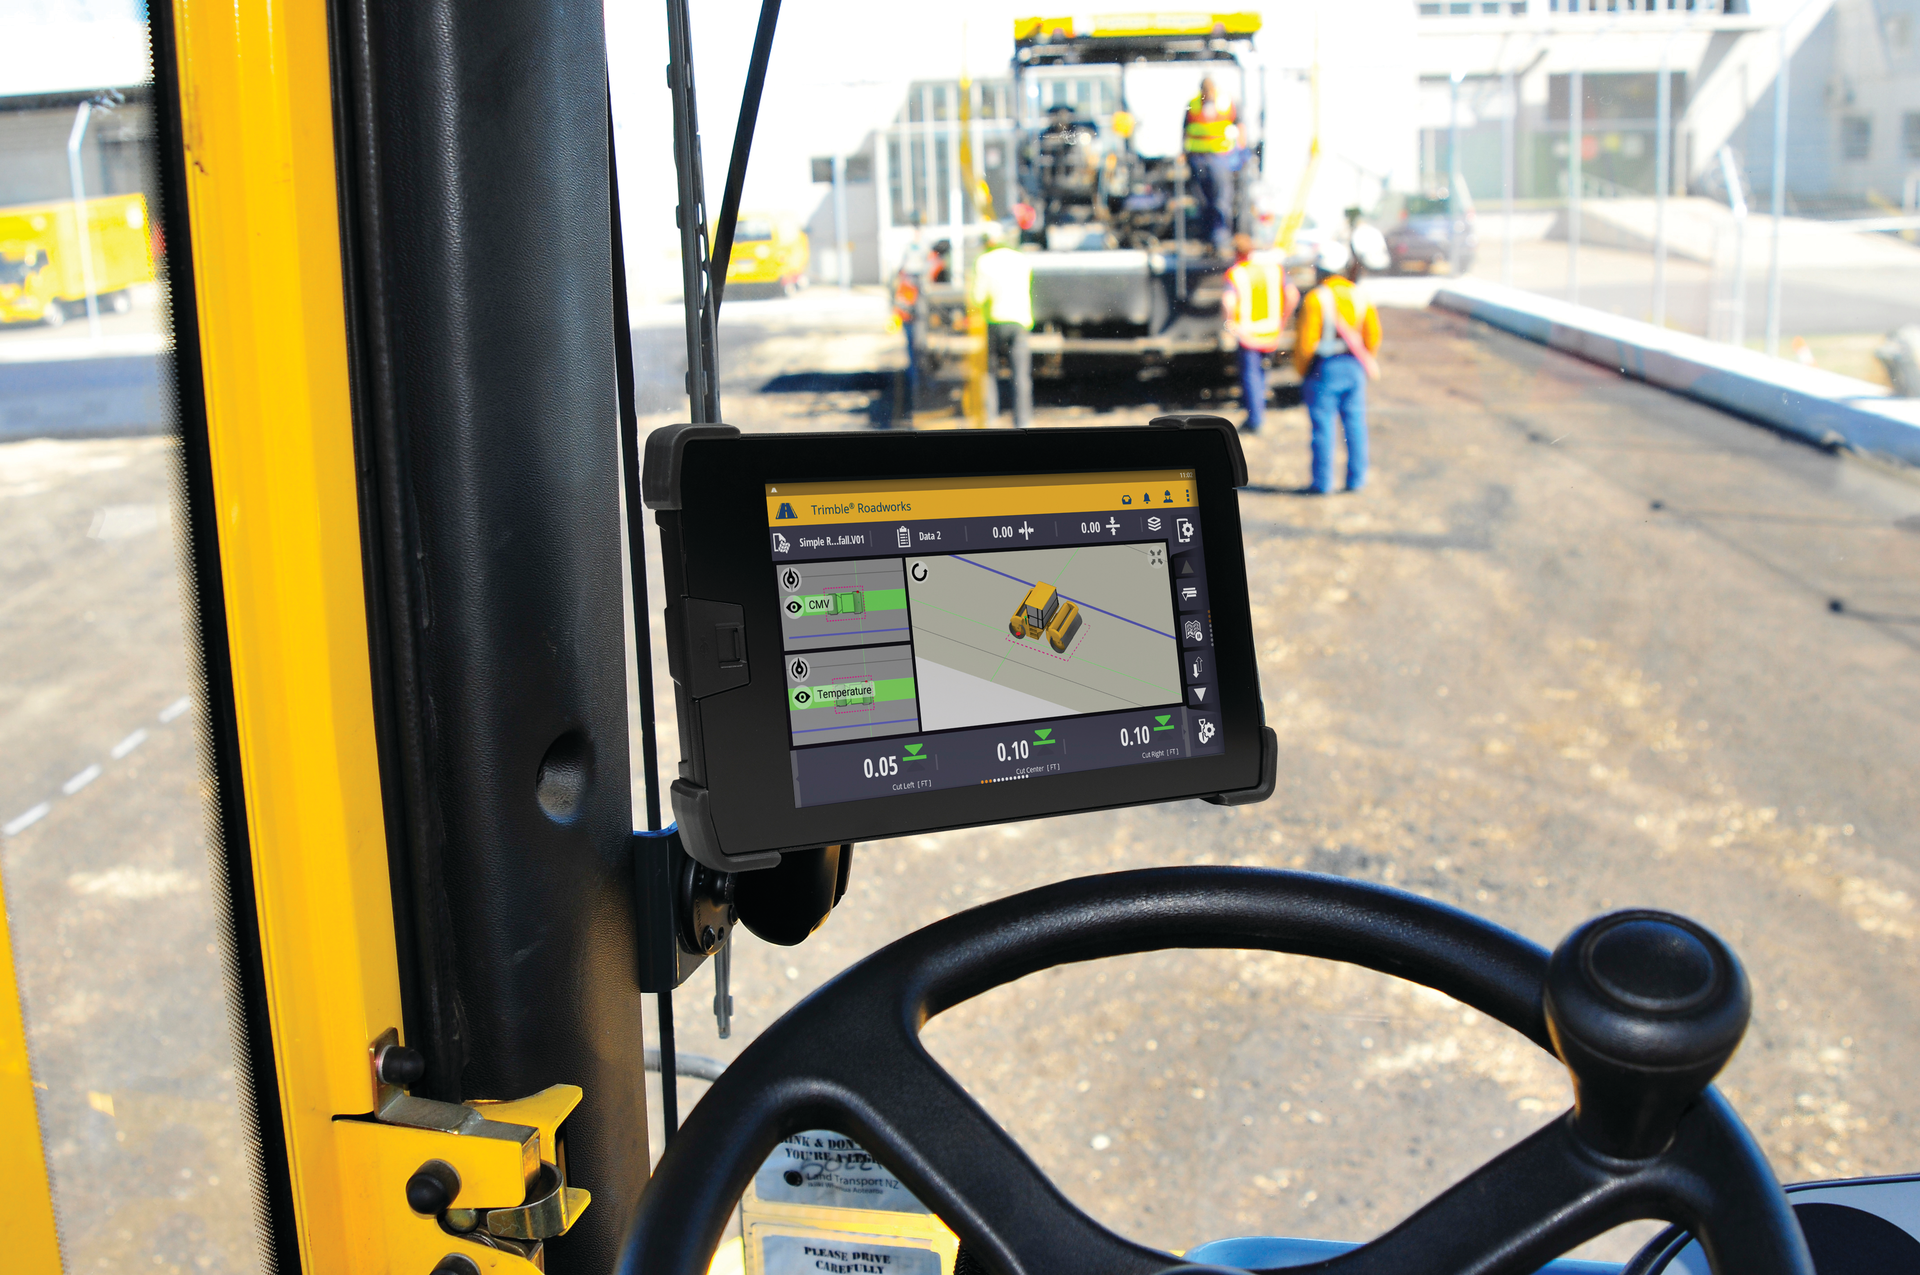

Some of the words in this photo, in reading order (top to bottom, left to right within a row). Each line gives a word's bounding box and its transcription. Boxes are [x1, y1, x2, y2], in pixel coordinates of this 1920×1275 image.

[858, 501, 912, 514] Roadworks
[992, 526, 1013, 538] 0.00
[1081, 521, 1101, 534] 0.00
[799, 536, 825, 549] Simple
[919, 531, 935, 541] Data
[936, 531, 942, 540] 2
[808, 599, 830, 610] CMV
[817, 685, 872, 700] Temperature
[1120, 725, 1150, 747] 0.10
[997, 740, 1029, 762] 0.10
[1142, 751, 1151, 759] Cut
[1151, 749, 1164, 759] Right
[863, 755, 899, 779] 0.05
[1016, 766, 1026, 775] Cut
[1026, 765, 1044, 774] Center
[892, 783, 903, 791] Cut
[903, 781, 915, 790] Left
[814, 1138, 824, 1148] &
[785, 1148, 831, 1161] YOU'RE
[806, 1173, 832, 1181] Land
[834, 1174, 883, 1187] Transport
[886, 1179, 899, 1189] NZ
[804, 1246, 848, 1262] PLEASE
[852, 1252, 891, 1265] DRIVE
[815, 1260, 884, 1274] CAREFULLY
